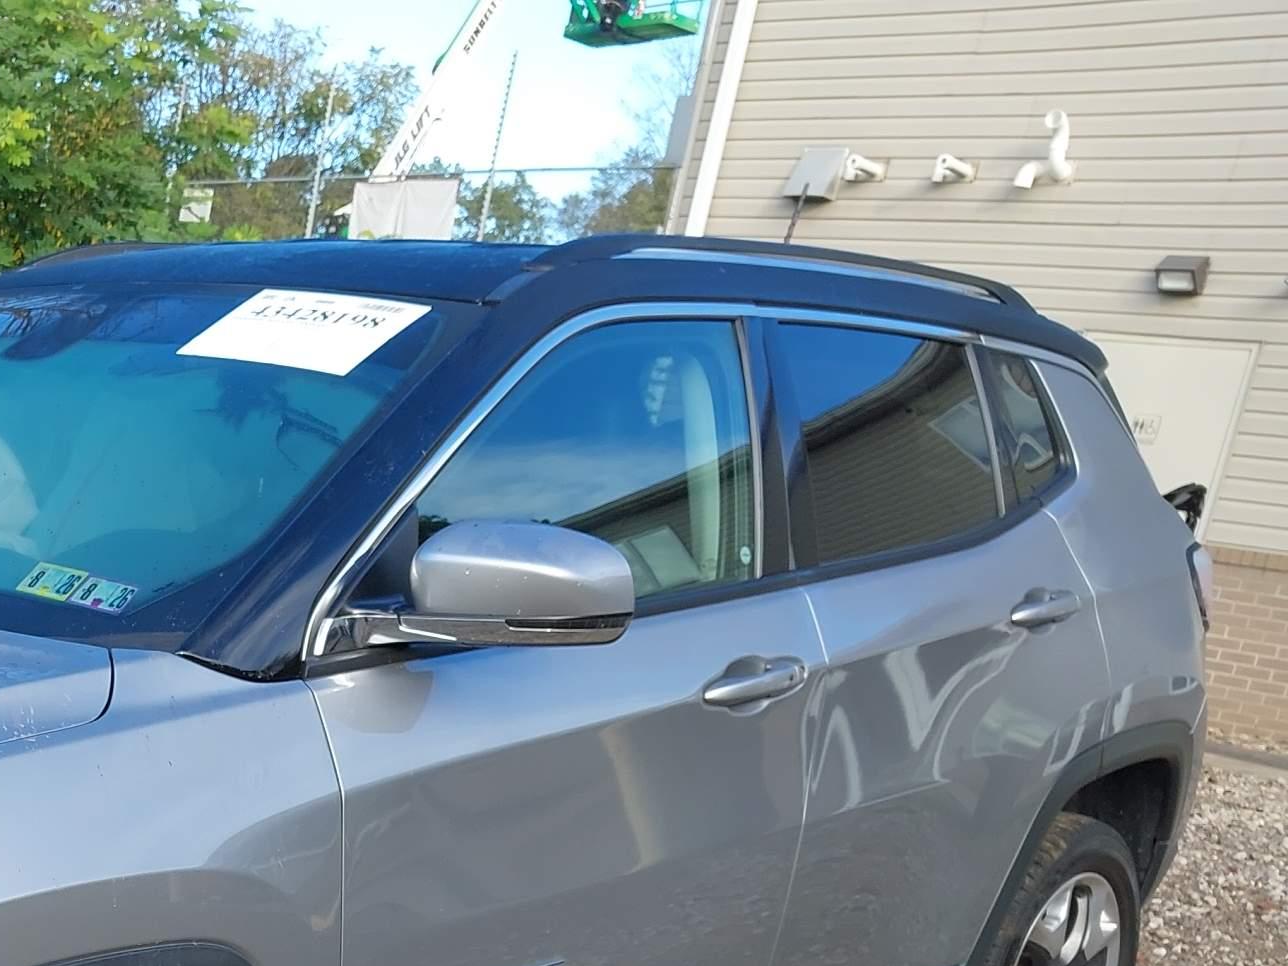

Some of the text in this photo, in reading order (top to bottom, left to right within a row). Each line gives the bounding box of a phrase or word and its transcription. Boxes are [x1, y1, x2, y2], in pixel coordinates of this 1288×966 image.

[250, 304, 387, 329] 43428198
[55, 574, 82, 596] 26
[108, 587, 136, 609] 26
